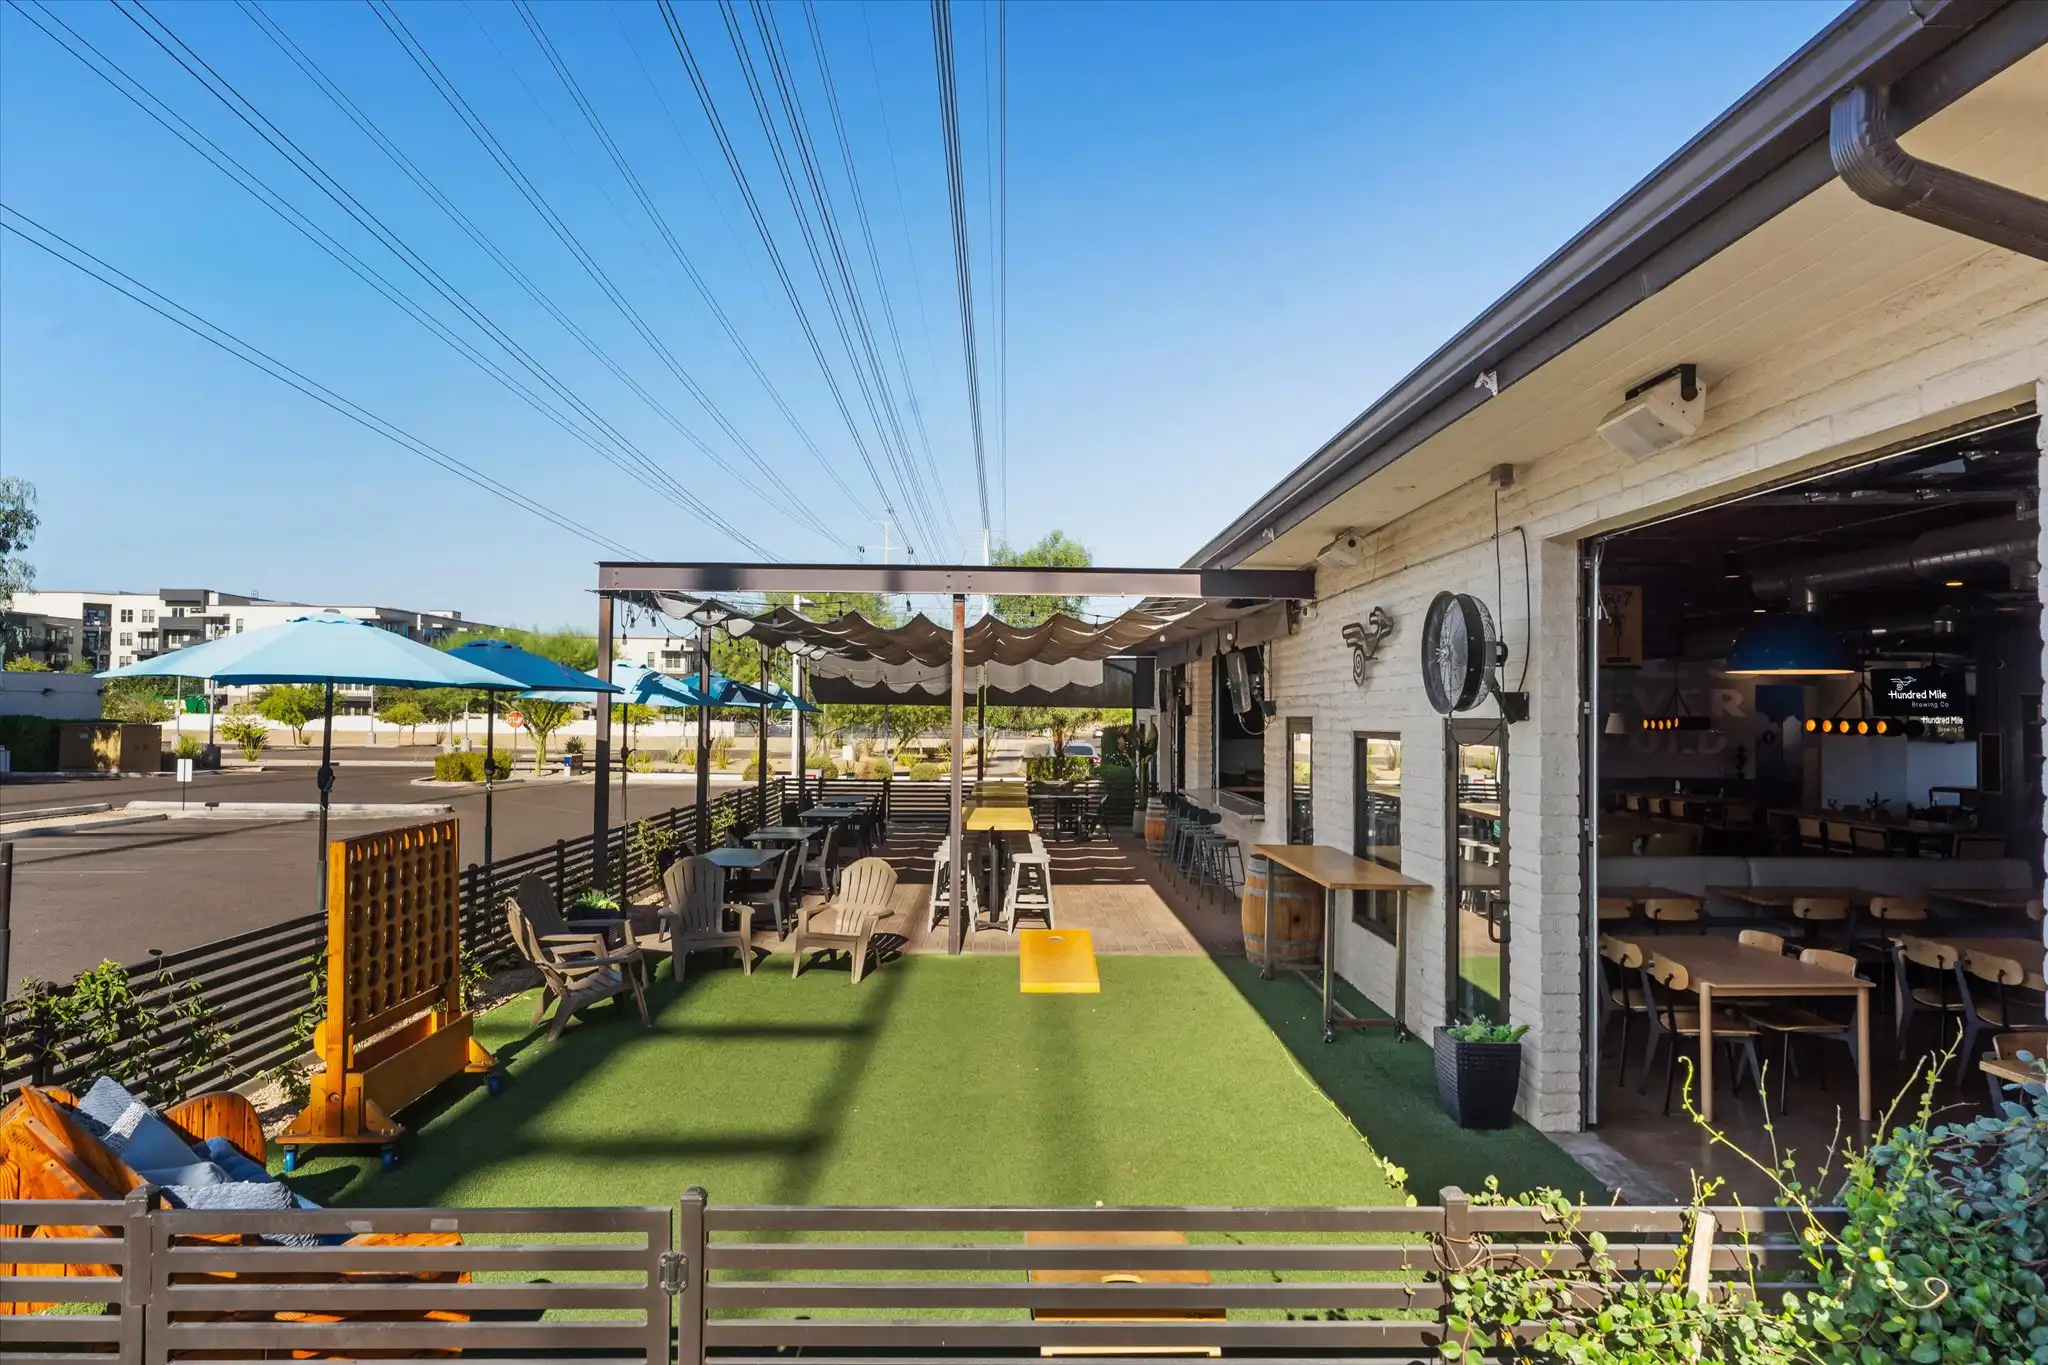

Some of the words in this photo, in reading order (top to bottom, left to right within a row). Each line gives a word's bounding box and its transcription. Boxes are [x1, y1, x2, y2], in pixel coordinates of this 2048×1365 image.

[1888, 690, 1927, 699] Hundred
[1928, 689, 1947, 699] Mile
[1920, 716, 1949, 724] Hundred
[1950, 716, 1964, 724] Mile
